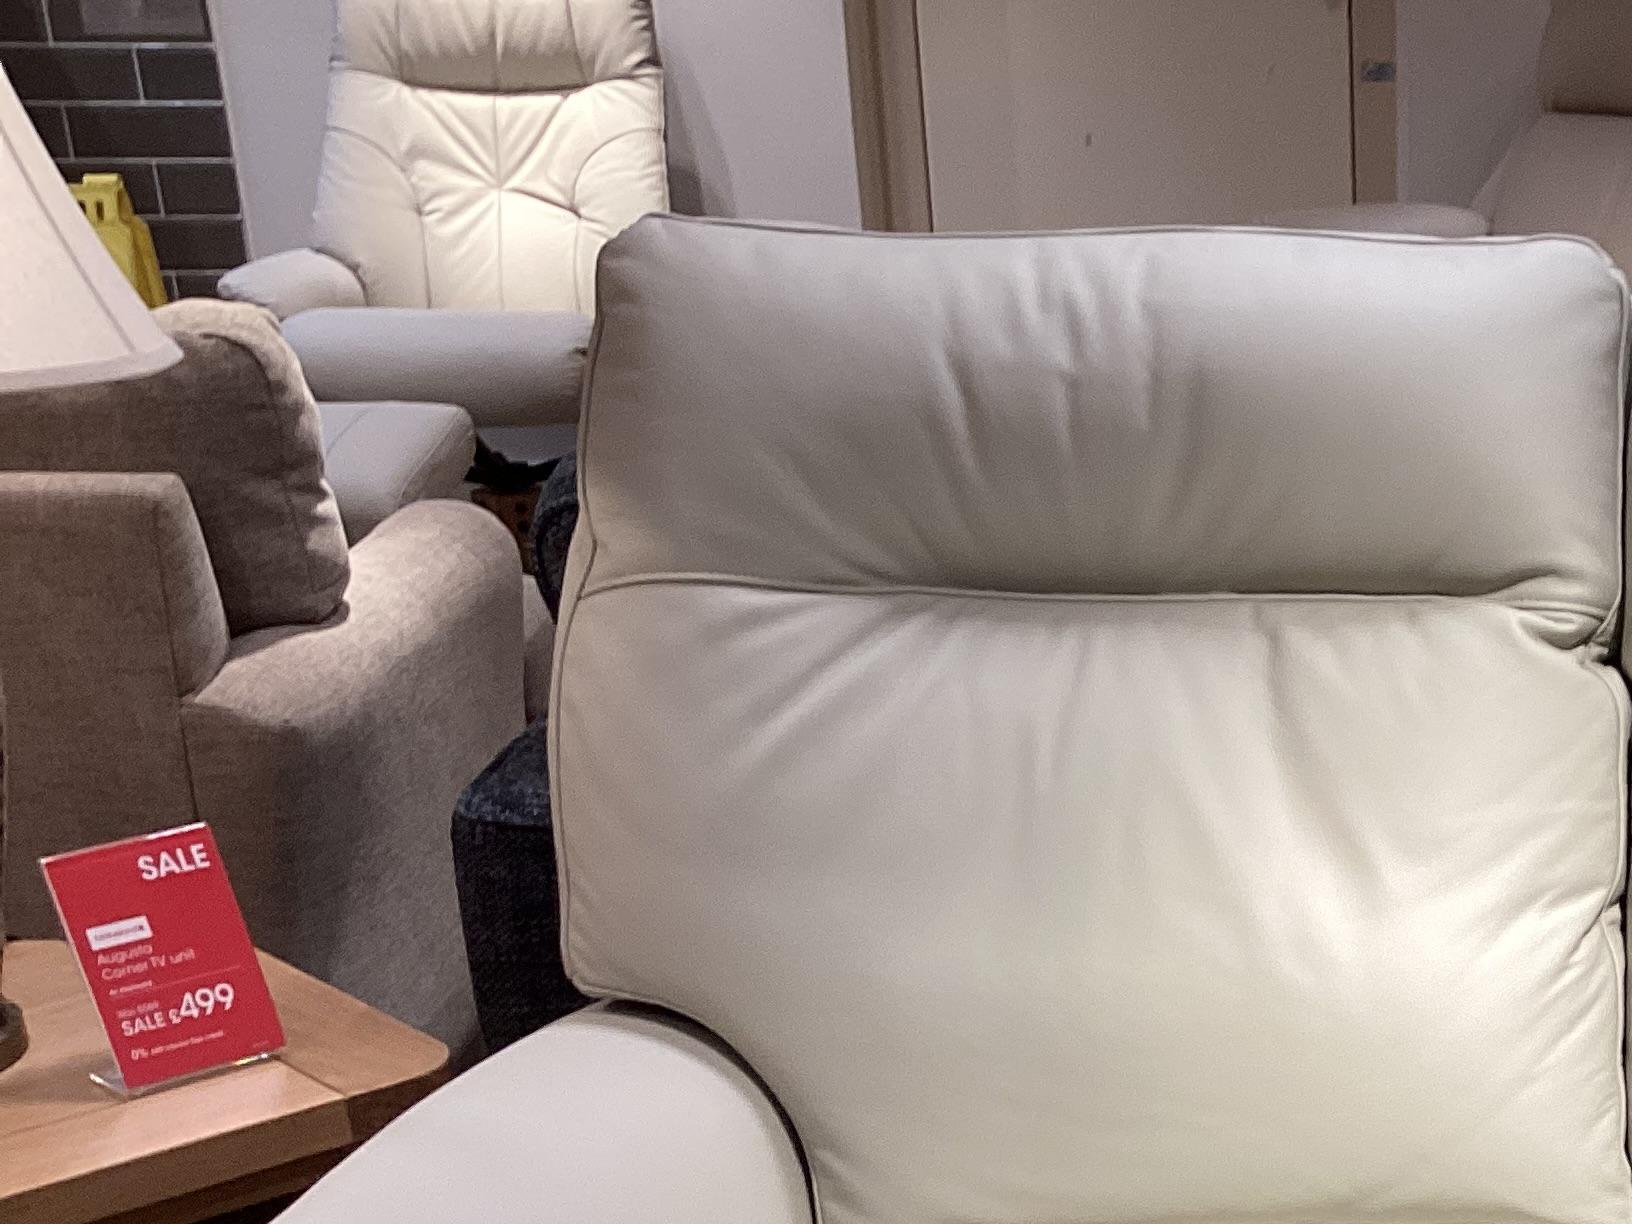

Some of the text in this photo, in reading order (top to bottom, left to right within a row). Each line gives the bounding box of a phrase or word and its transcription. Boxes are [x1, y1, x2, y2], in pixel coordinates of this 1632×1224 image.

[137, 843, 211, 880] SALE
[101, 948, 195, 980] Corner TV unit
[121, 1011, 166, 1037] SALE
[168, 982, 235, 1024] £499
